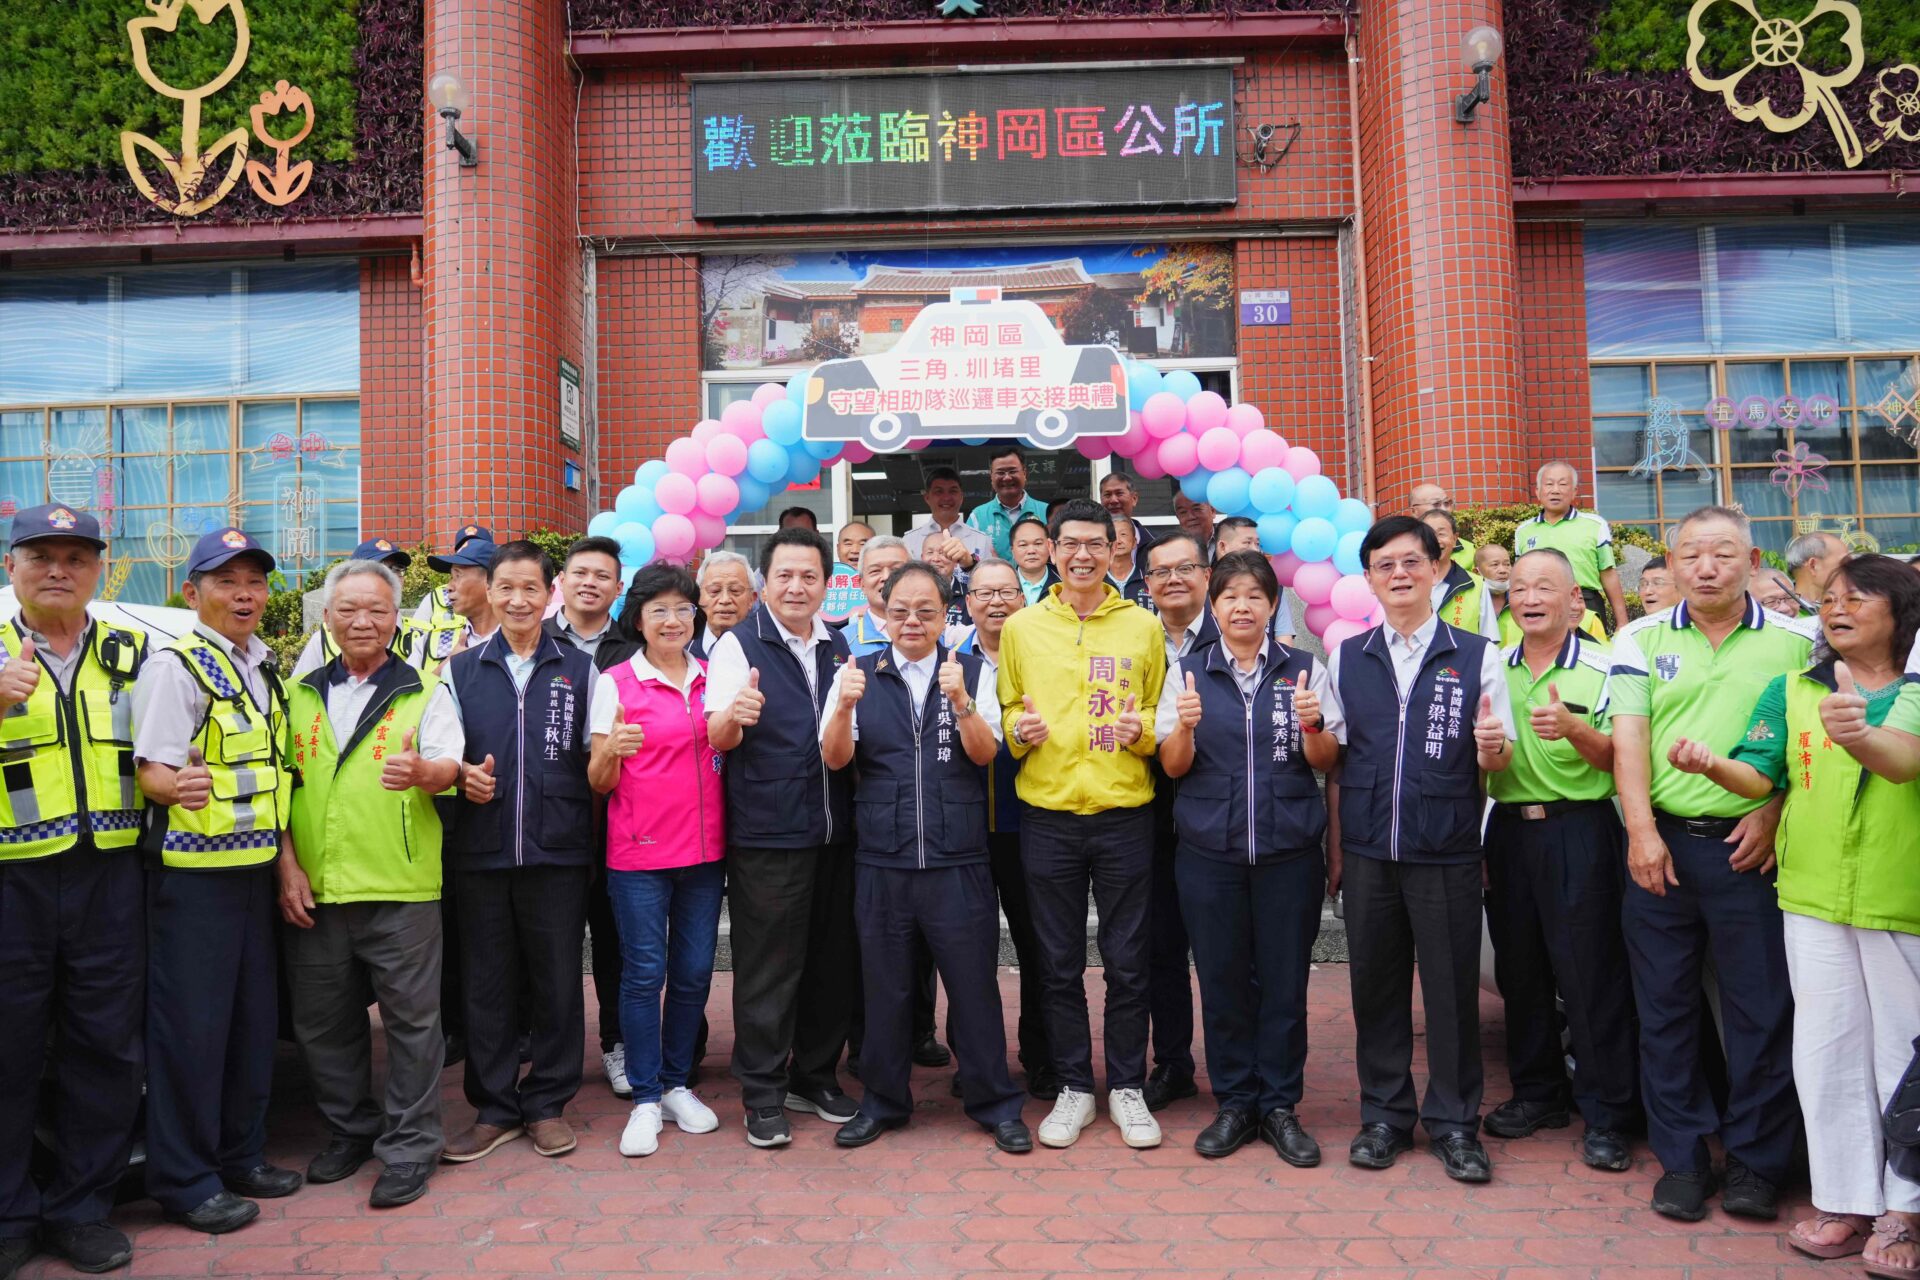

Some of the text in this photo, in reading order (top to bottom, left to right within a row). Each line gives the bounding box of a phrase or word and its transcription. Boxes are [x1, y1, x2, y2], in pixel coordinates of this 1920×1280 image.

[703, 102, 1223, 171] 歡迎蒞臨神岡區公所
[930, 323, 1023, 347] 神岡區
[1254, 304, 1278, 323] 30
[829, 383, 1117, 414] 守望相助隊巡邏車交接典禮
[1713, 401, 1830, 422] 五馬文化
[280, 486, 316, 562] 神岡
[562, 693, 575, 751] 神岡區北庄里
[1088, 656, 1116, 753] 周永鴻
[1447, 686, 1463, 739] 神岡區公所
[294, 733, 305, 777] 張明
